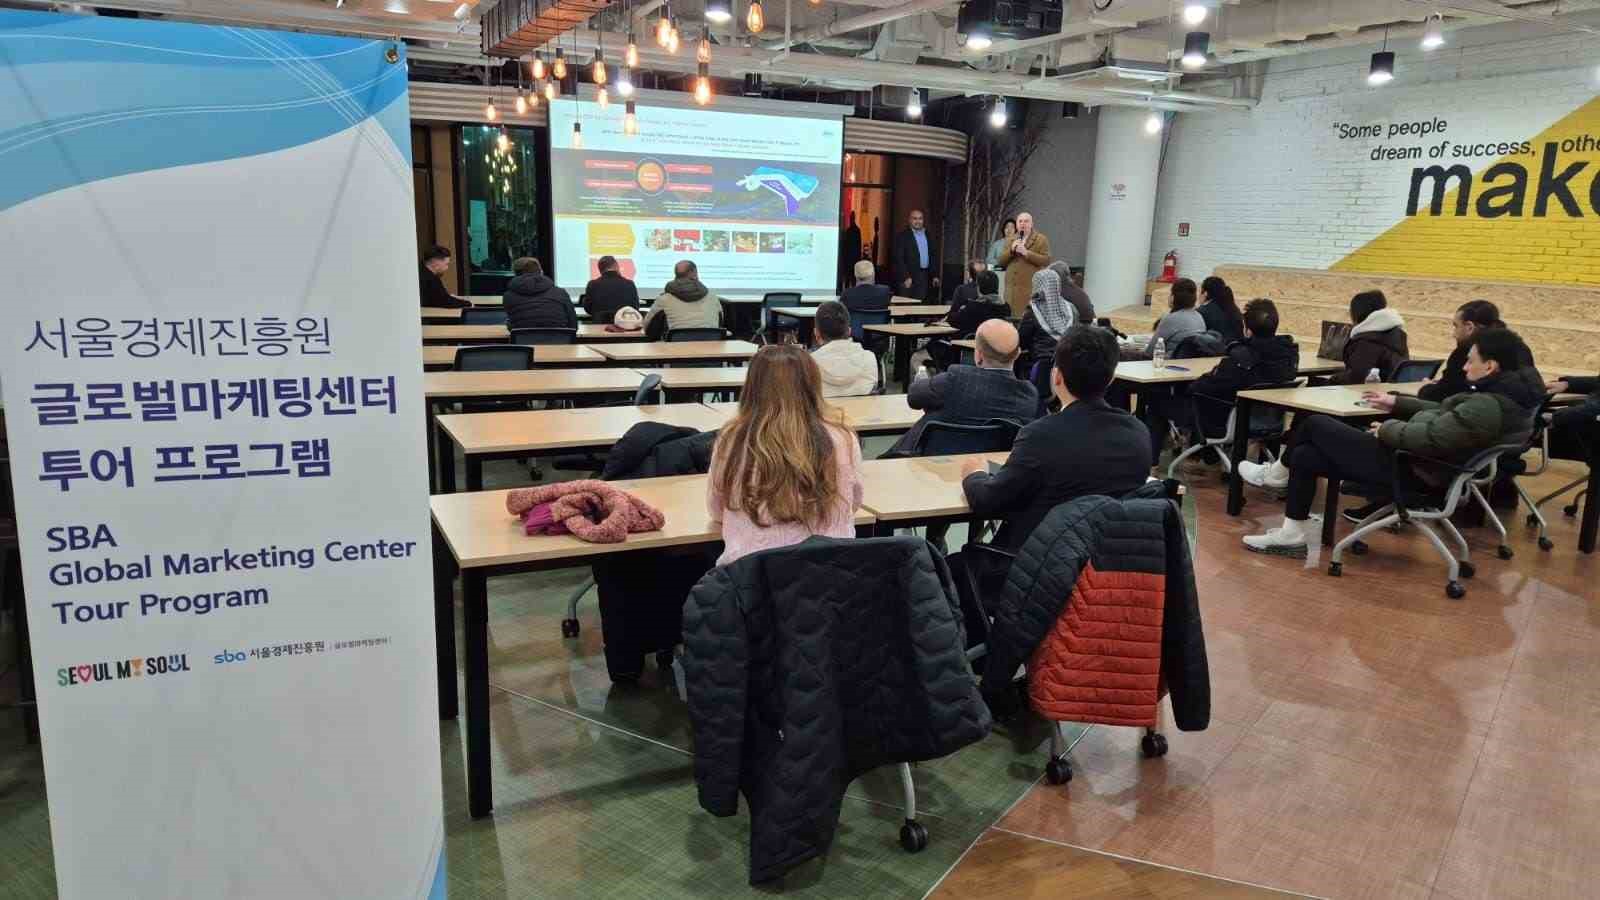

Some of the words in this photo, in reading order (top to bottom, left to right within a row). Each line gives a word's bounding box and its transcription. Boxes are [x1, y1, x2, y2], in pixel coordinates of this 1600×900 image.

[1388, 117, 1447, 139] people
[1370, 144, 1422, 161] dream
[1428, 141, 1449, 158] of
[1452, 140, 1536, 157] success,
[1406, 142, 1600, 218] mak
[24, 316, 332, 359] 서울경제진흥원
[30, 375, 398, 426] 글로벌마케팅센터
[38, 446, 135, 492] 투어
[153, 438, 332, 483] 프로그램
[46, 523, 117, 553] SBA
[49, 555, 152, 586] Global
[163, 545, 315, 577] Marketing
[324, 538, 417, 563] Center
[52, 598, 130, 625] Tour
[140, 587, 269, 616] Program
[145, 654, 191, 676] SOUL
[214, 648, 247, 664] sba
[249, 640, 325, 660] 서울경제진흥원
